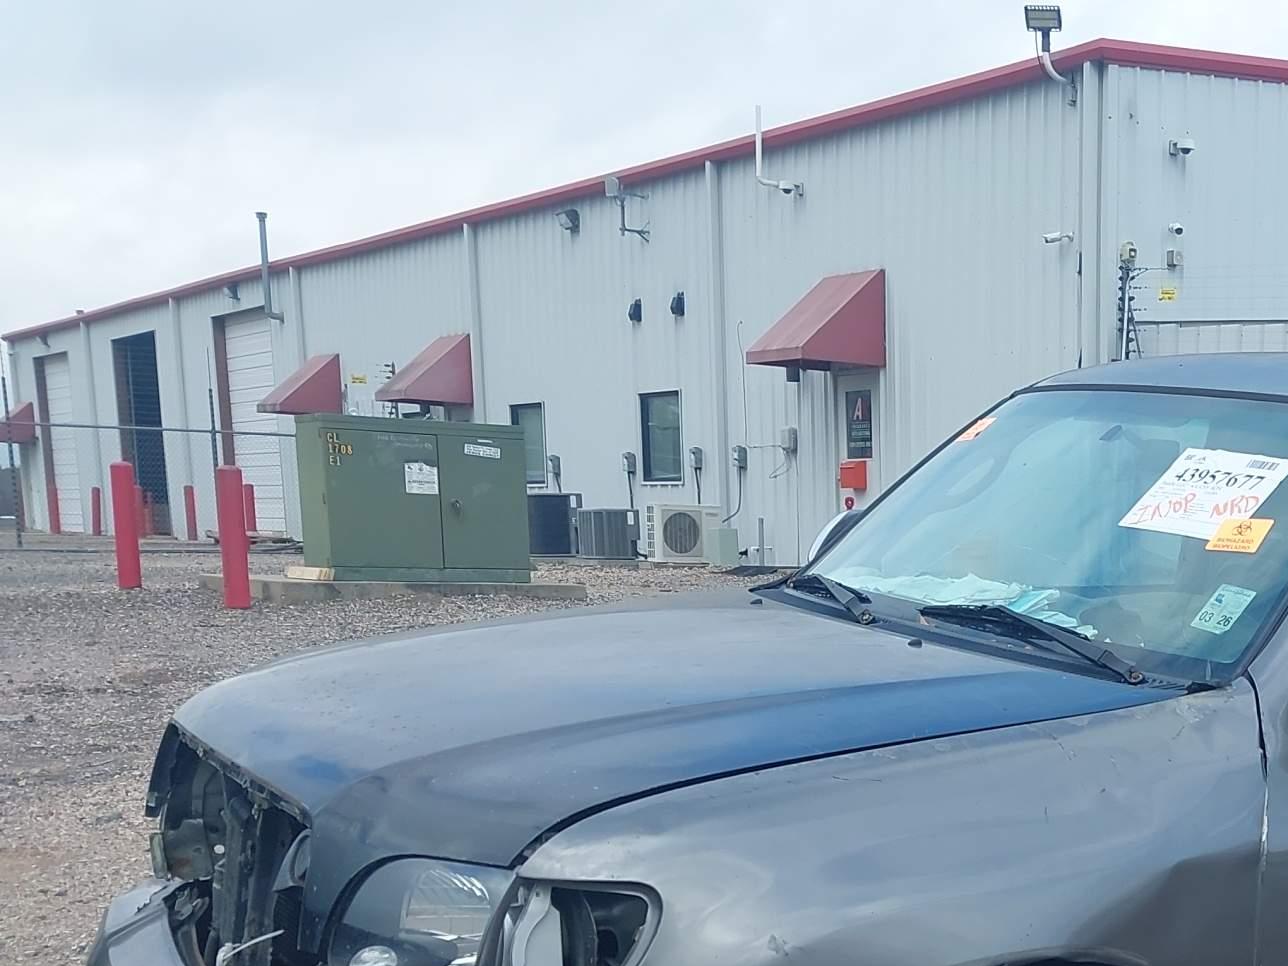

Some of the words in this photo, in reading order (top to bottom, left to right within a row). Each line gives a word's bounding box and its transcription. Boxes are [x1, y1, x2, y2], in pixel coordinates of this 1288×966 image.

[327, 432, 341, 442] CL
[328, 443, 353, 456] 1708
[329, 455, 342, 467] E1
[1175, 467, 1267, 491] 43957677
[1128, 493, 1196, 524] INOP
[1199, 611, 1214, 623] 03
[1216, 615, 1232, 627] 26
